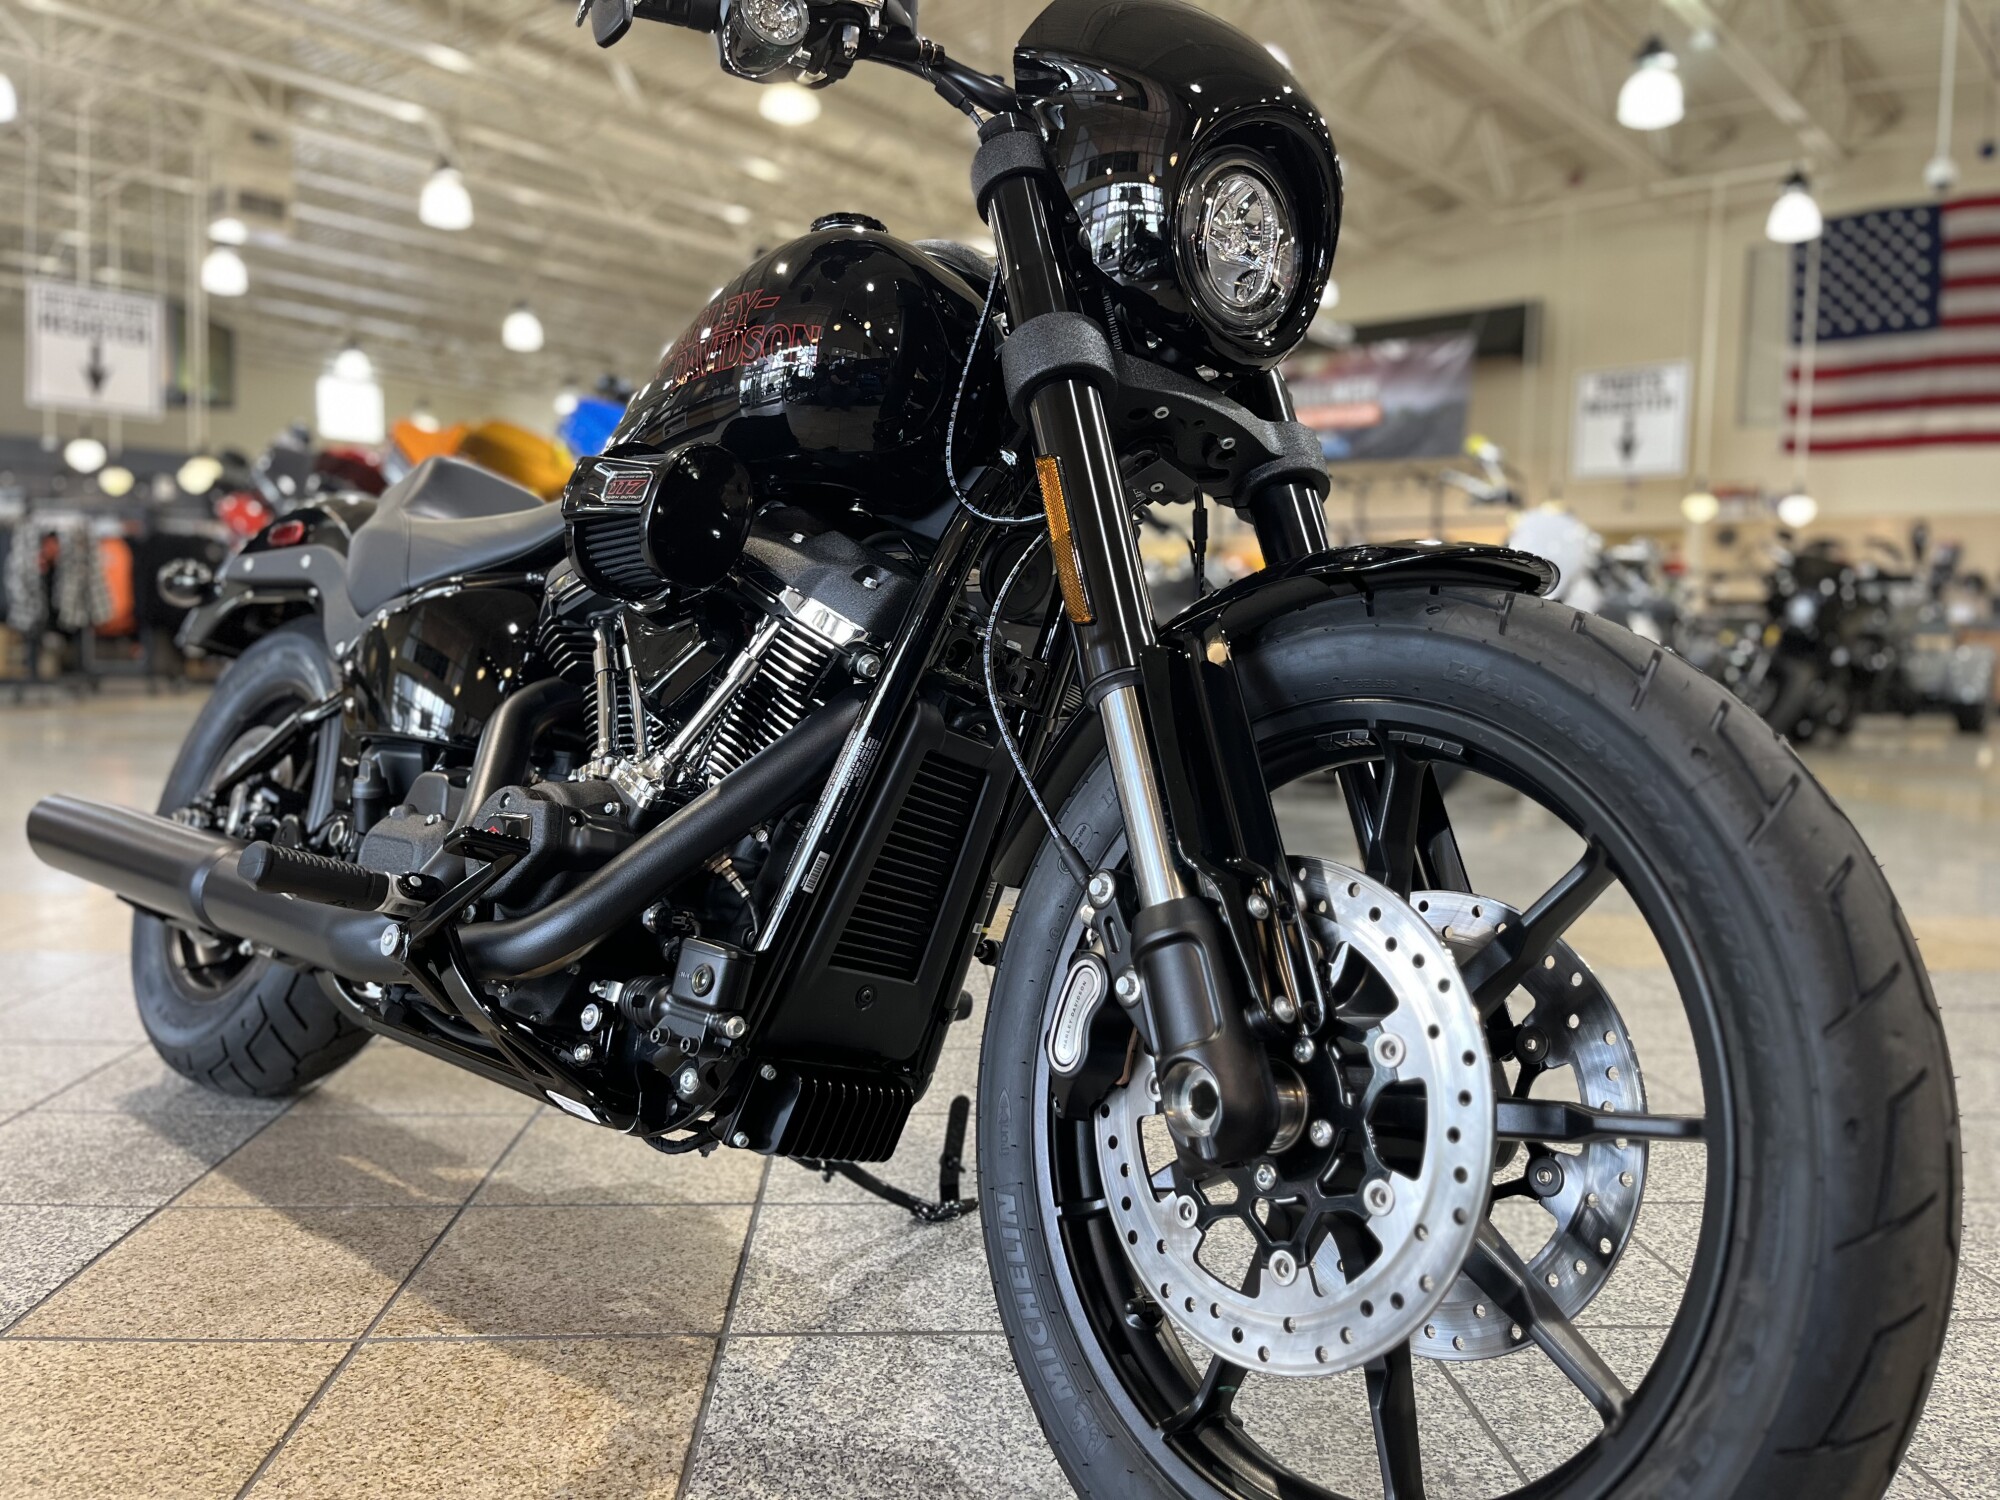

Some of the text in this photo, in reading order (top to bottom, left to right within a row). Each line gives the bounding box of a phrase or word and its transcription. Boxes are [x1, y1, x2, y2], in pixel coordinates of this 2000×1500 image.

[670, 323, 822, 390] DAVIDSON
[607, 479, 648, 495] 117
[1062, 981, 1087, 1050] HARLEY-DAVIDSON
[996, 1192, 1075, 1400] MICHELIN
